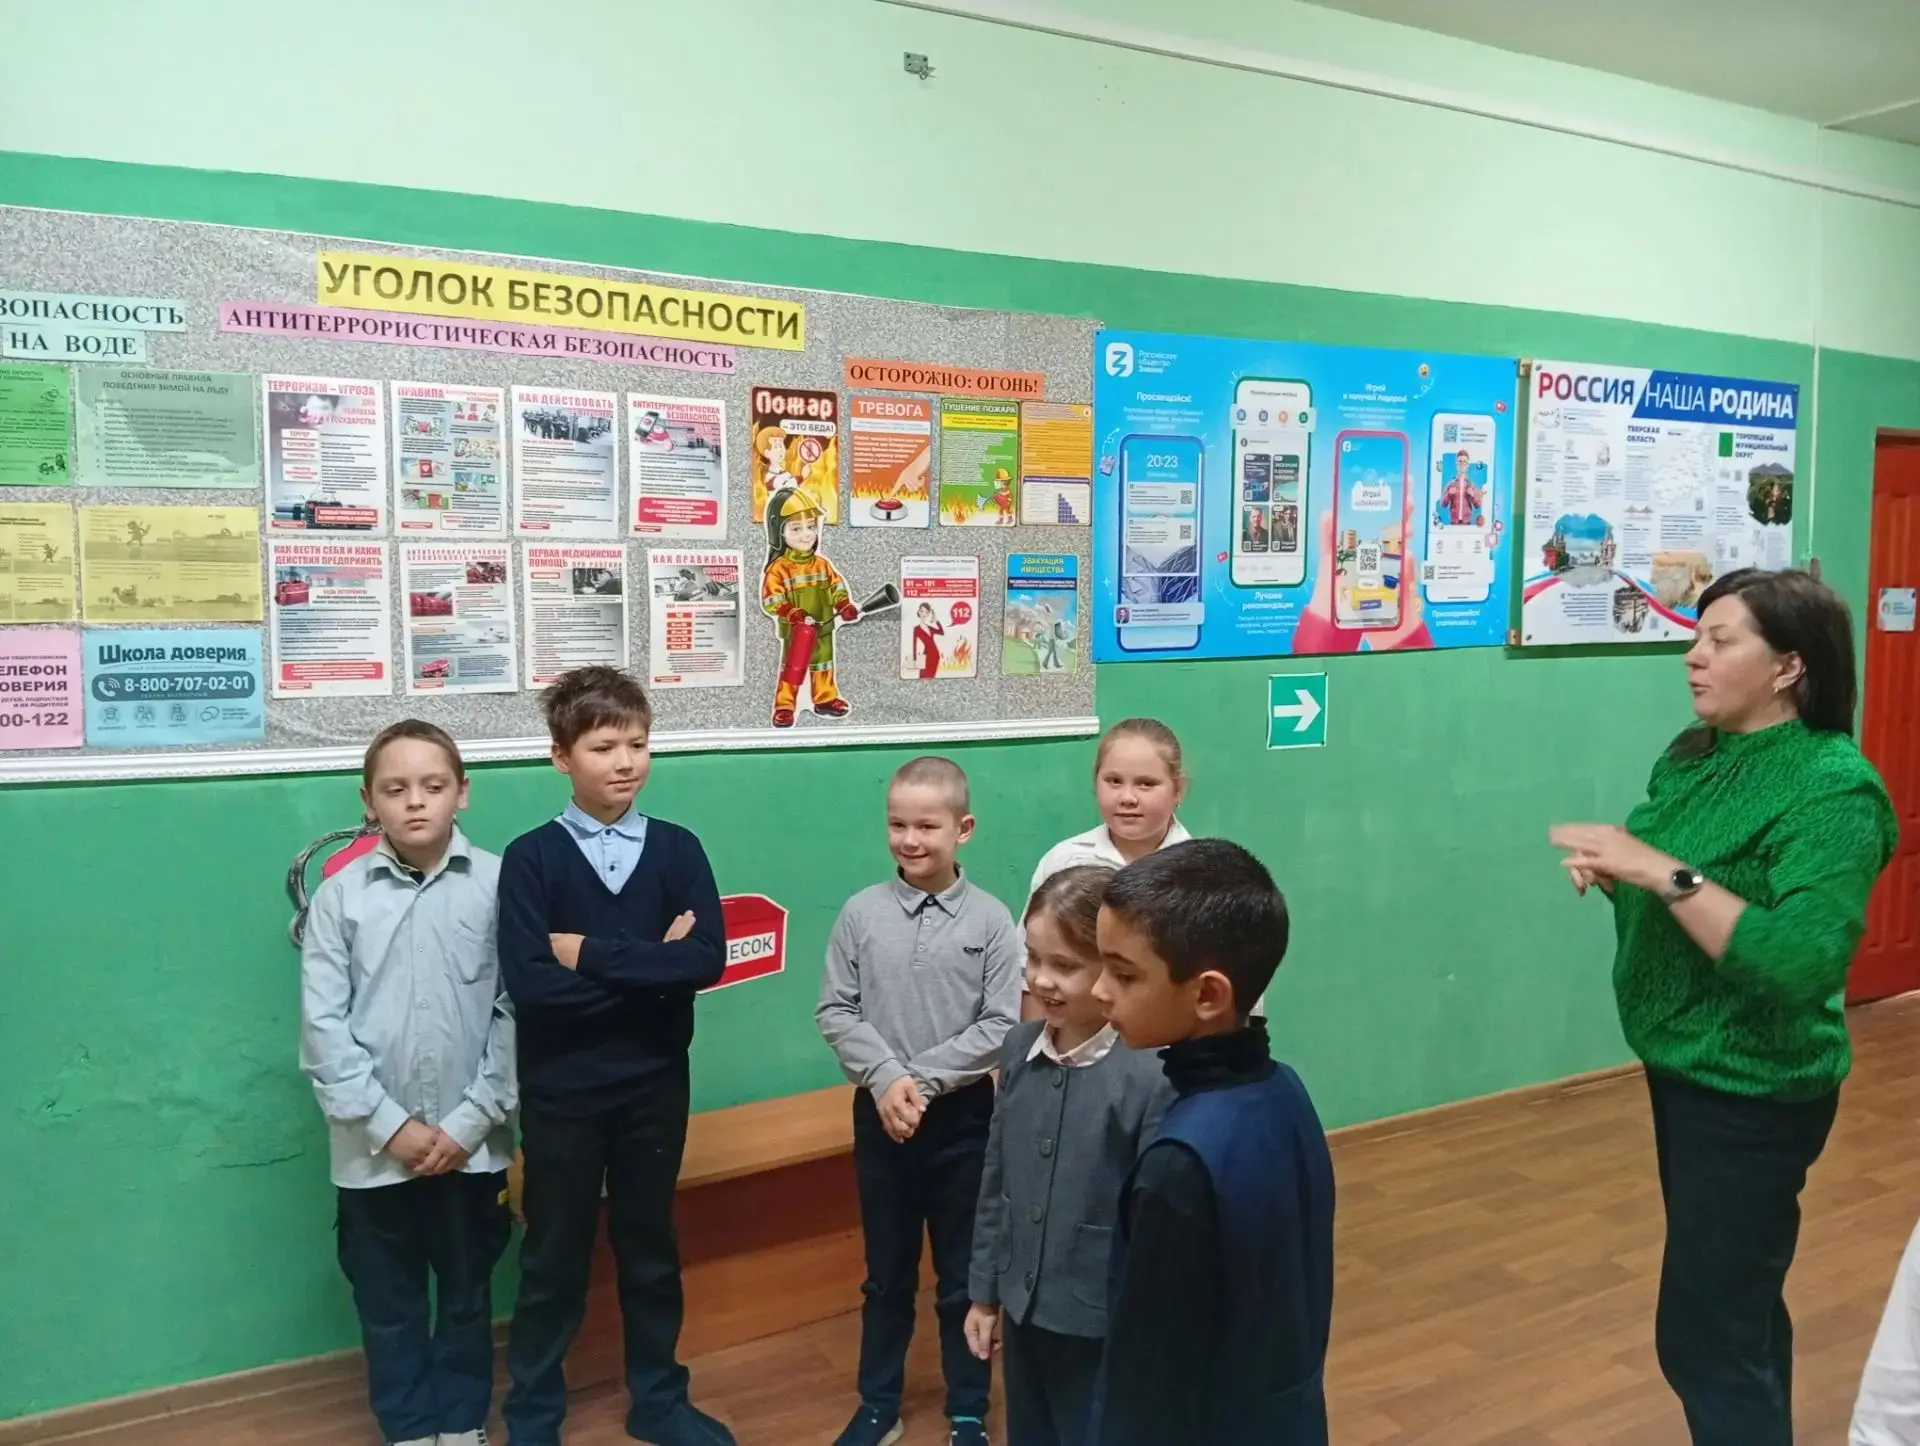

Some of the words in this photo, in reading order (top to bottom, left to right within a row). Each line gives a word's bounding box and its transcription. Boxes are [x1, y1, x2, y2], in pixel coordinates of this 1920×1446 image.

[323, 260, 494, 309] УГОЛОК
[508, 280, 800, 341] БЕЗОПАСНОСТИ
[10, 332, 49, 351] НА
[65, 335, 137, 357] ВОДЕ
[226, 308, 557, 351] АНТИТЕРРОРИСТИЧЕСКАЯ
[563, 334, 734, 370] БЕЗОПАСНОСТЬ
[120, 371, 169, 381] ОСНОВНЫЕ
[171, 373, 212, 382] ПРАВИЛА
[850, 364, 972, 390] ОСТОРОЖНО:
[976, 375, 1038, 393] ОГОНЬ!
[102, 381, 156, 391] ПОВЕДЕНИЯ
[158, 383, 191, 393] ЗИМОЙ
[192, 385, 204, 393] НА
[207, 386, 230, 394] ЛЬДУ
[267, 380, 328, 393] ТЕРРОРИЗМ
[338, 384, 375, 396] УГРОЗА
[398, 387, 445, 399] ПРАВИЛА
[518, 392, 538, 403] КАК
[541, 395, 614, 409] ДЕЙСТВОВАТЬ
[1538, 372, 1635, 405] РОССИЯ
[1645, 381, 1705, 411] НАША
[1709, 388, 1794, 419] РОДИНА
[755, 391, 835, 420] Пожар
[858, 400, 924, 417] ТРЕВОГА
[943, 403, 980, 412] ТУШЕНИЕ
[982, 404, 1016, 413] ПОЖАРА
[789, 422, 807, 431] ЭТО
[808, 423, 834, 433] БЕДА!
[1627, 425, 1660, 434] ТВЕРСКАЯ
[1626, 435, 1656, 443] ОБЛАСТЬ
[1146, 454, 1178, 468] 20:23
[274, 545, 292, 554] КАК
[293, 545, 321, 554] ВЕСТИ
[322, 546, 346, 555] СЕБЯ
[354, 546, 383, 555] КАКИЕ
[528, 548, 560, 558] ПЕРВАЯ
[561, 549, 623, 558] МЕДИЦИНСКАЯ
[275, 555, 319, 565] ДЕЙСТВИЯ
[321, 556, 383, 566] ПРЕДПРИНЯТЬ
[528, 558, 568, 568] ПОМОЩЬ
[652, 554, 673, 564] КАК
[675, 555, 738, 564] ПРАВИЛЬНО
[1021, 557, 1065, 565] ЭВАКУАЦИЯ
[1020, 566, 1065, 574] ИМУЩЕСТВА
[906, 589, 918, 597] 112
[952, 607, 970, 618] 112
[99, 644, 166, 665] Школа
[170, 647, 247, 664] доверия
[0, 680, 68, 692] ОВЕРИЯ
[124, 675, 250, 692] 8-800-707-02-01
[0, 712, 70, 728] 00-122
[730, 935, 774, 961] ЕСОК
